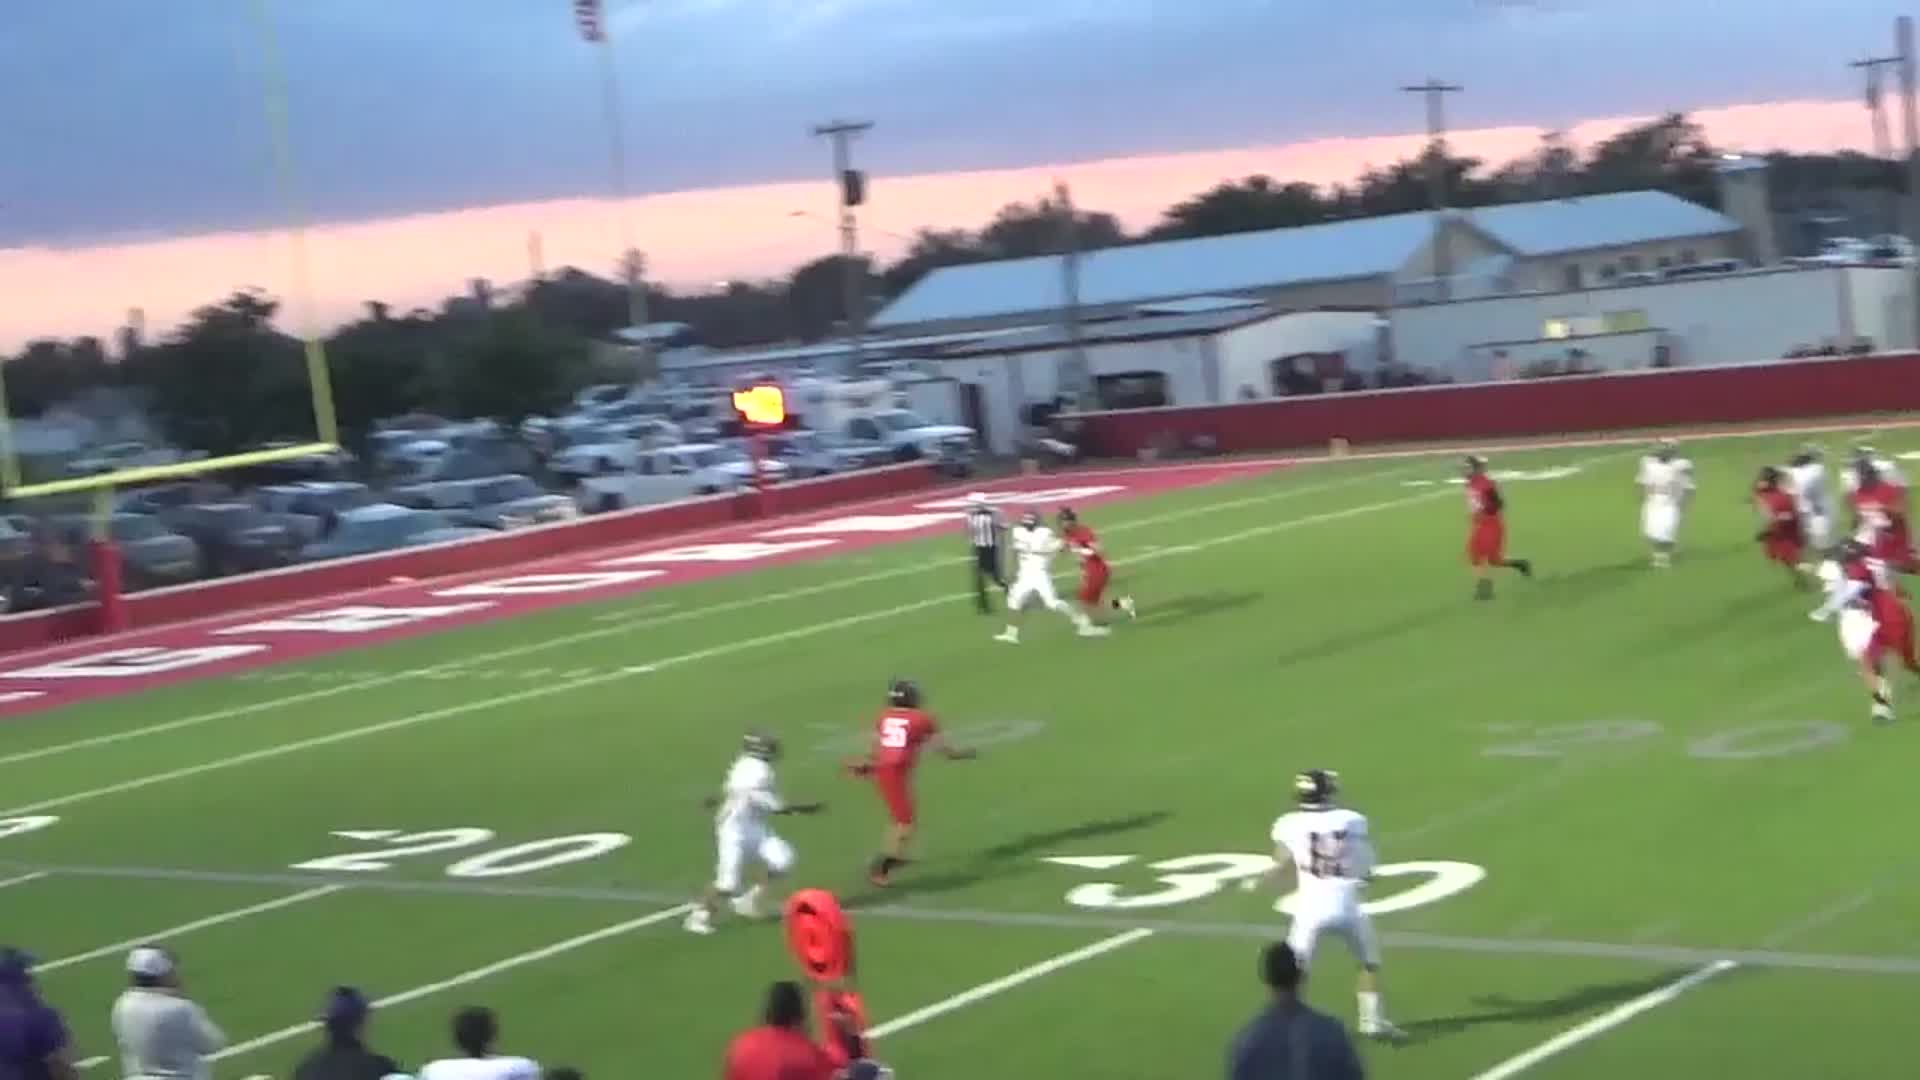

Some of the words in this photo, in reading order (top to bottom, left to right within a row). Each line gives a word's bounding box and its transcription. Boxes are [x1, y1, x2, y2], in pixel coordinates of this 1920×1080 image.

[0, 485, 1128, 700] GHORNS
[288, 827, 633, 877] 20
[1063, 853, 1488, 916] 30
